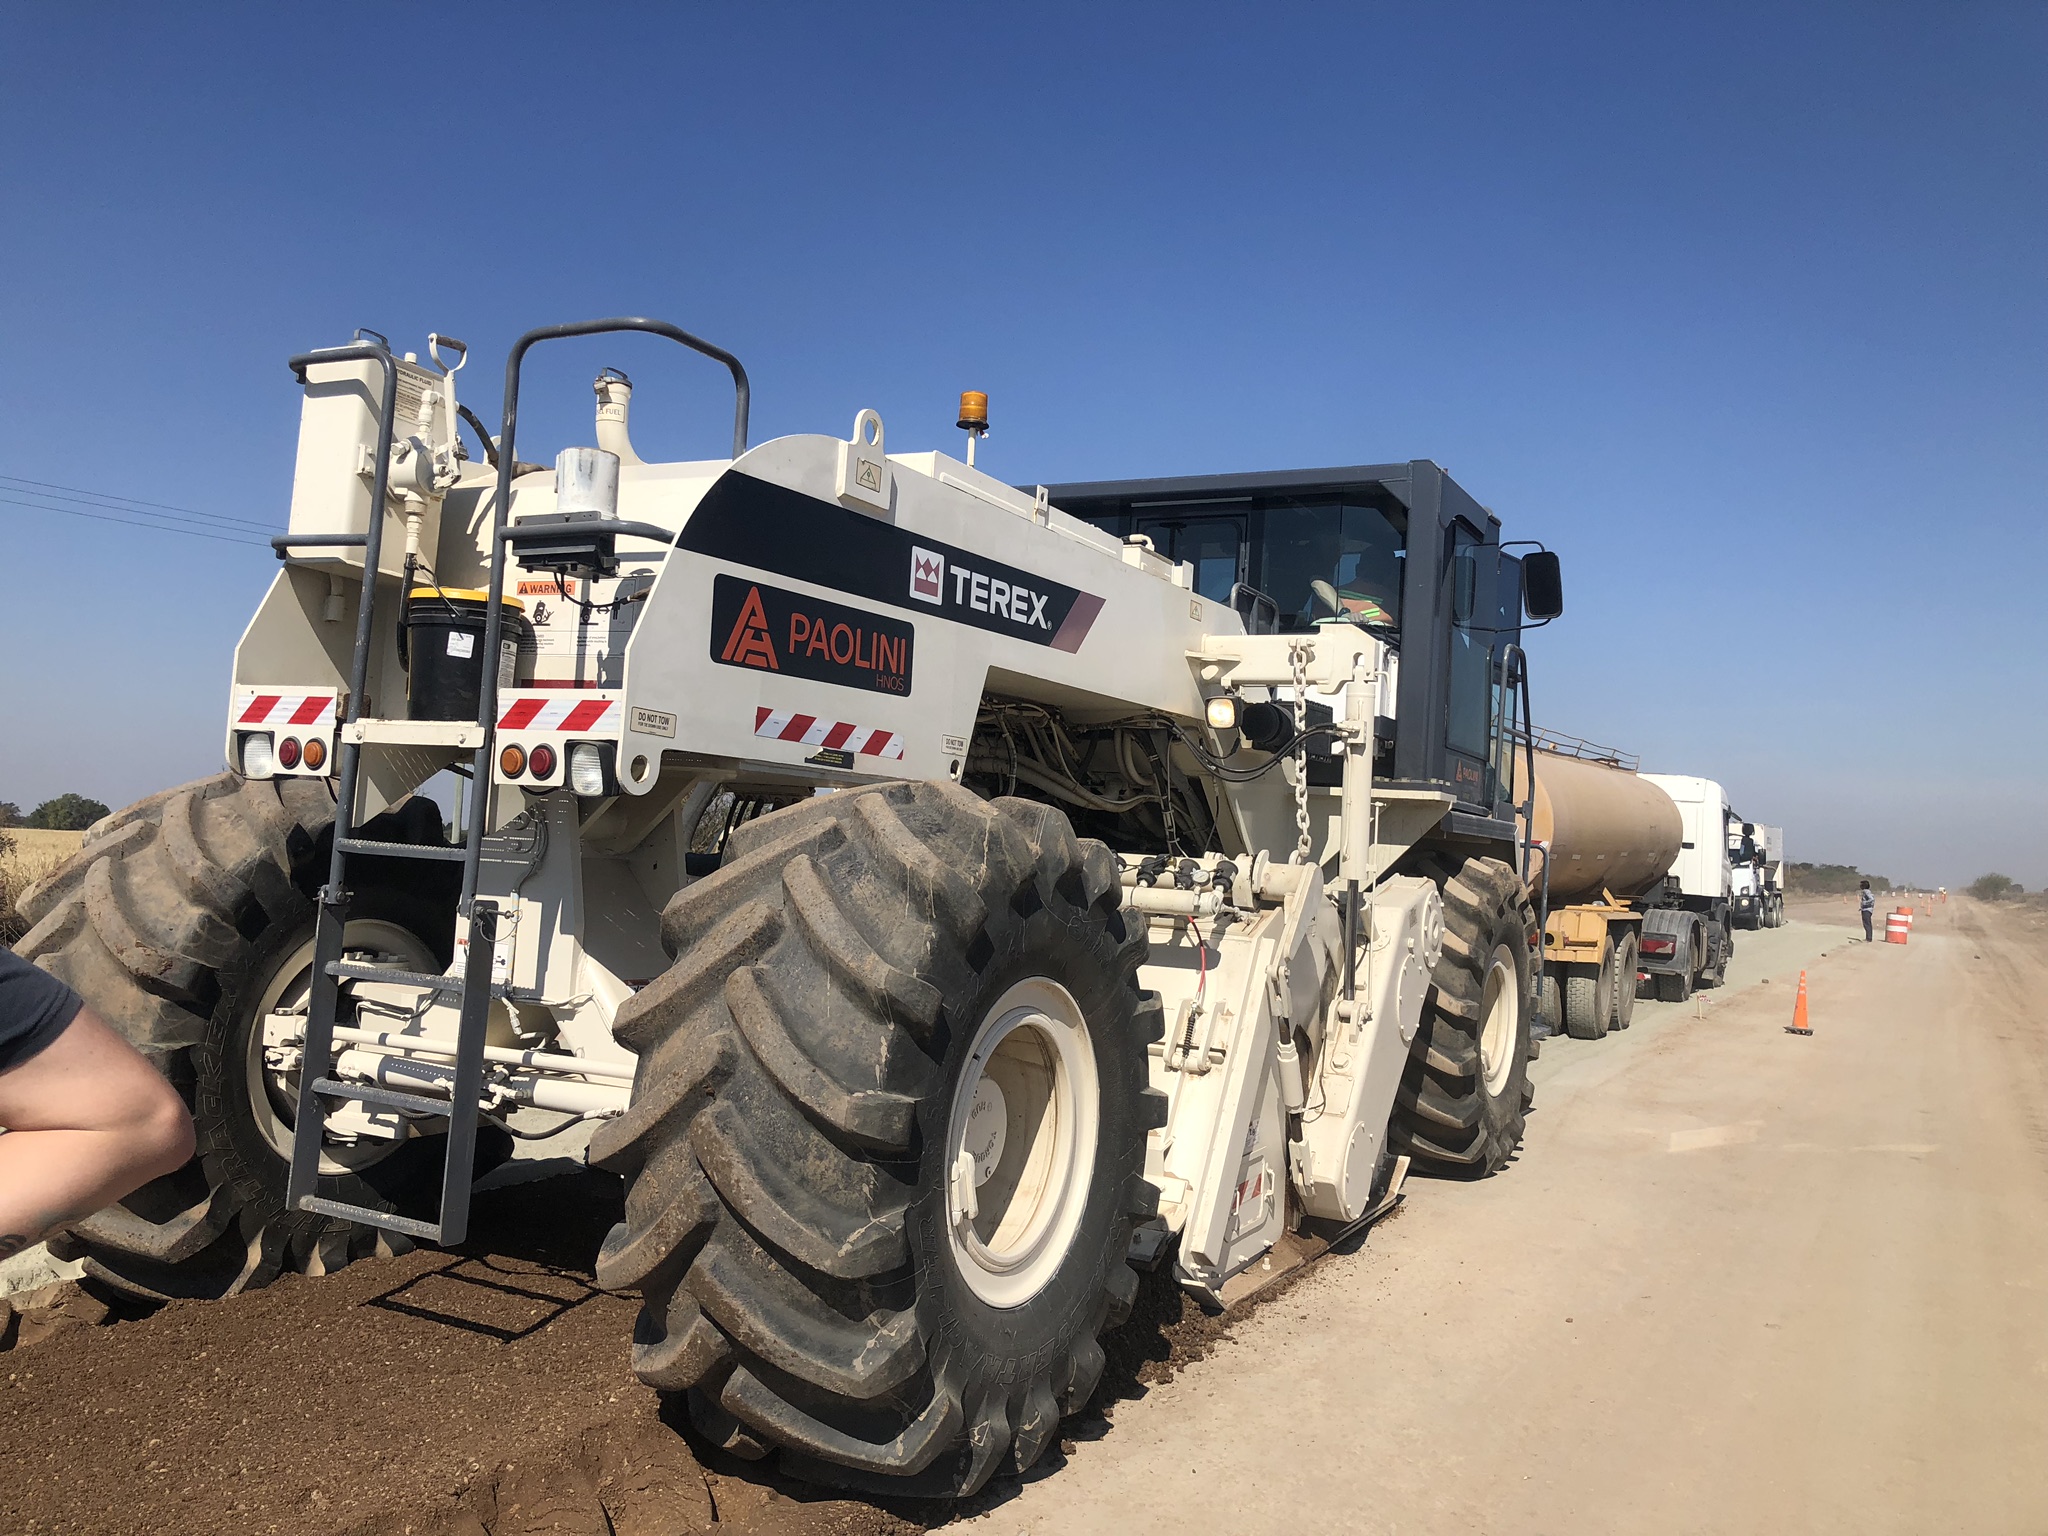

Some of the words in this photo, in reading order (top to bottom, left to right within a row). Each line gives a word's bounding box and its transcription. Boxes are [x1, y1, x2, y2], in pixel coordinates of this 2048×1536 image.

[420, 378, 432, 386] FLUID
[530, 583, 572, 594] WARNIG
[788, 612, 906, 676] PAOLINI
[875, 673, 905, 692] HNOS
[638, 712, 646, 722] DO
[647, 714, 658, 724] NOT
[658, 716, 671, 726] TOW
